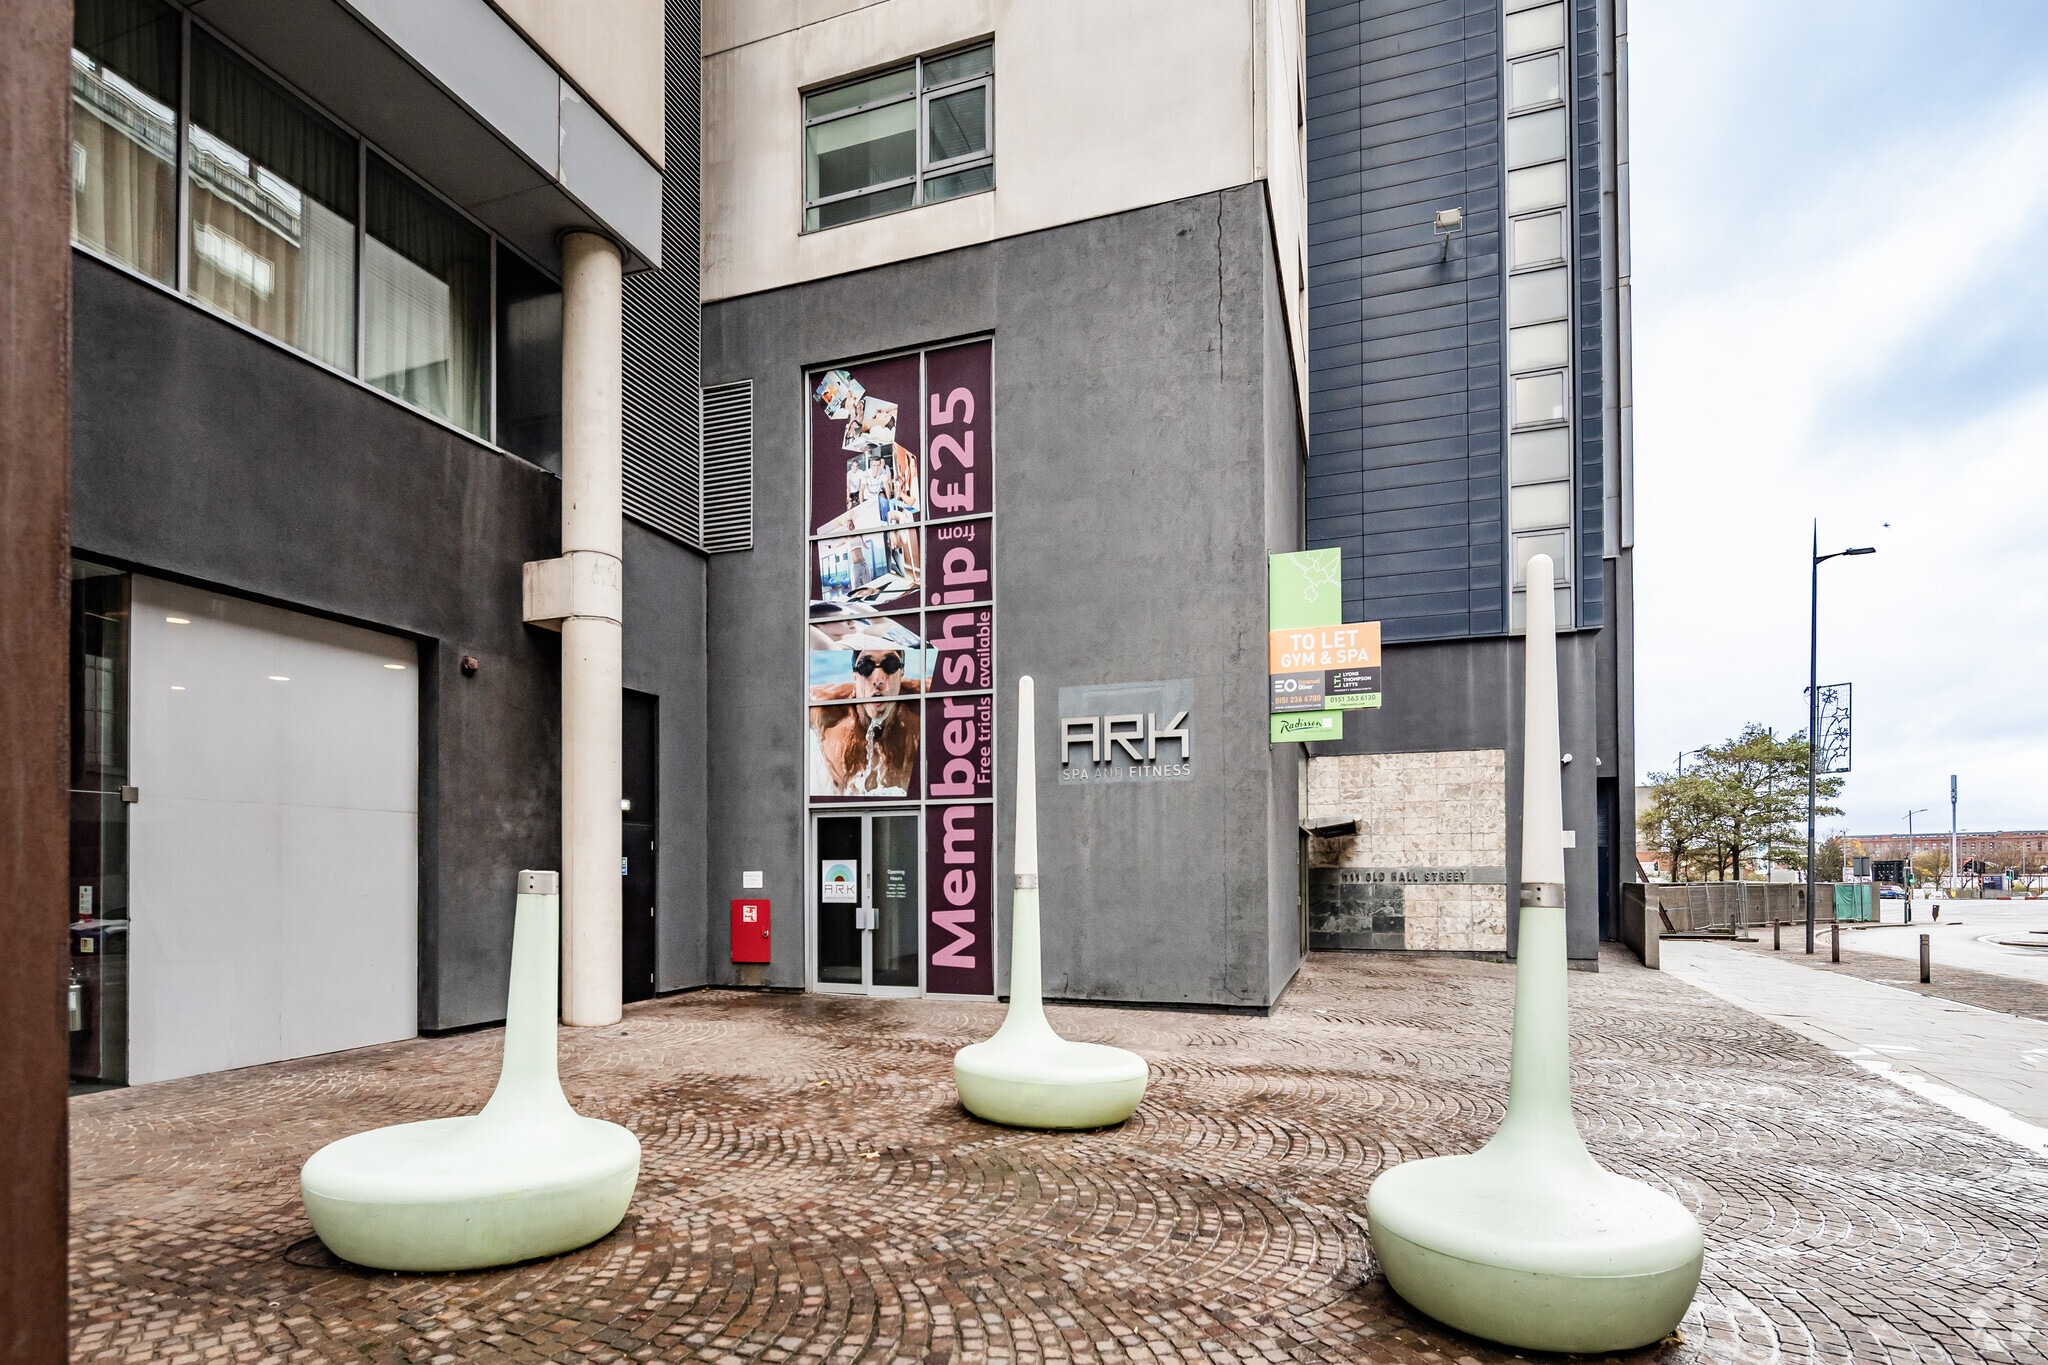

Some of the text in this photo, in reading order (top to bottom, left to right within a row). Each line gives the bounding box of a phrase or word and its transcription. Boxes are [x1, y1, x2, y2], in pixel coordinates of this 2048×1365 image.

[1290, 630, 1358, 651] TO LET
[1281, 648, 1369, 668] GYM & SPA
[930, 387, 988, 968] Membership from £25
[977, 611, 991, 784] Free trials available
[1275, 697, 1288, 705] 0151
[1304, 695, 1321, 703] 6700
[1280, 717, 1322, 734] Radisson
[1061, 710, 1190, 764] ARK
[1063, 764, 1191, 780] SPA AND FITNESS
[1365, 871, 1386, 882] OLD
[1390, 871, 1418, 882] HALL
[1424, 870, 1467, 882] STREET
[824, 884, 855, 895] ARK
